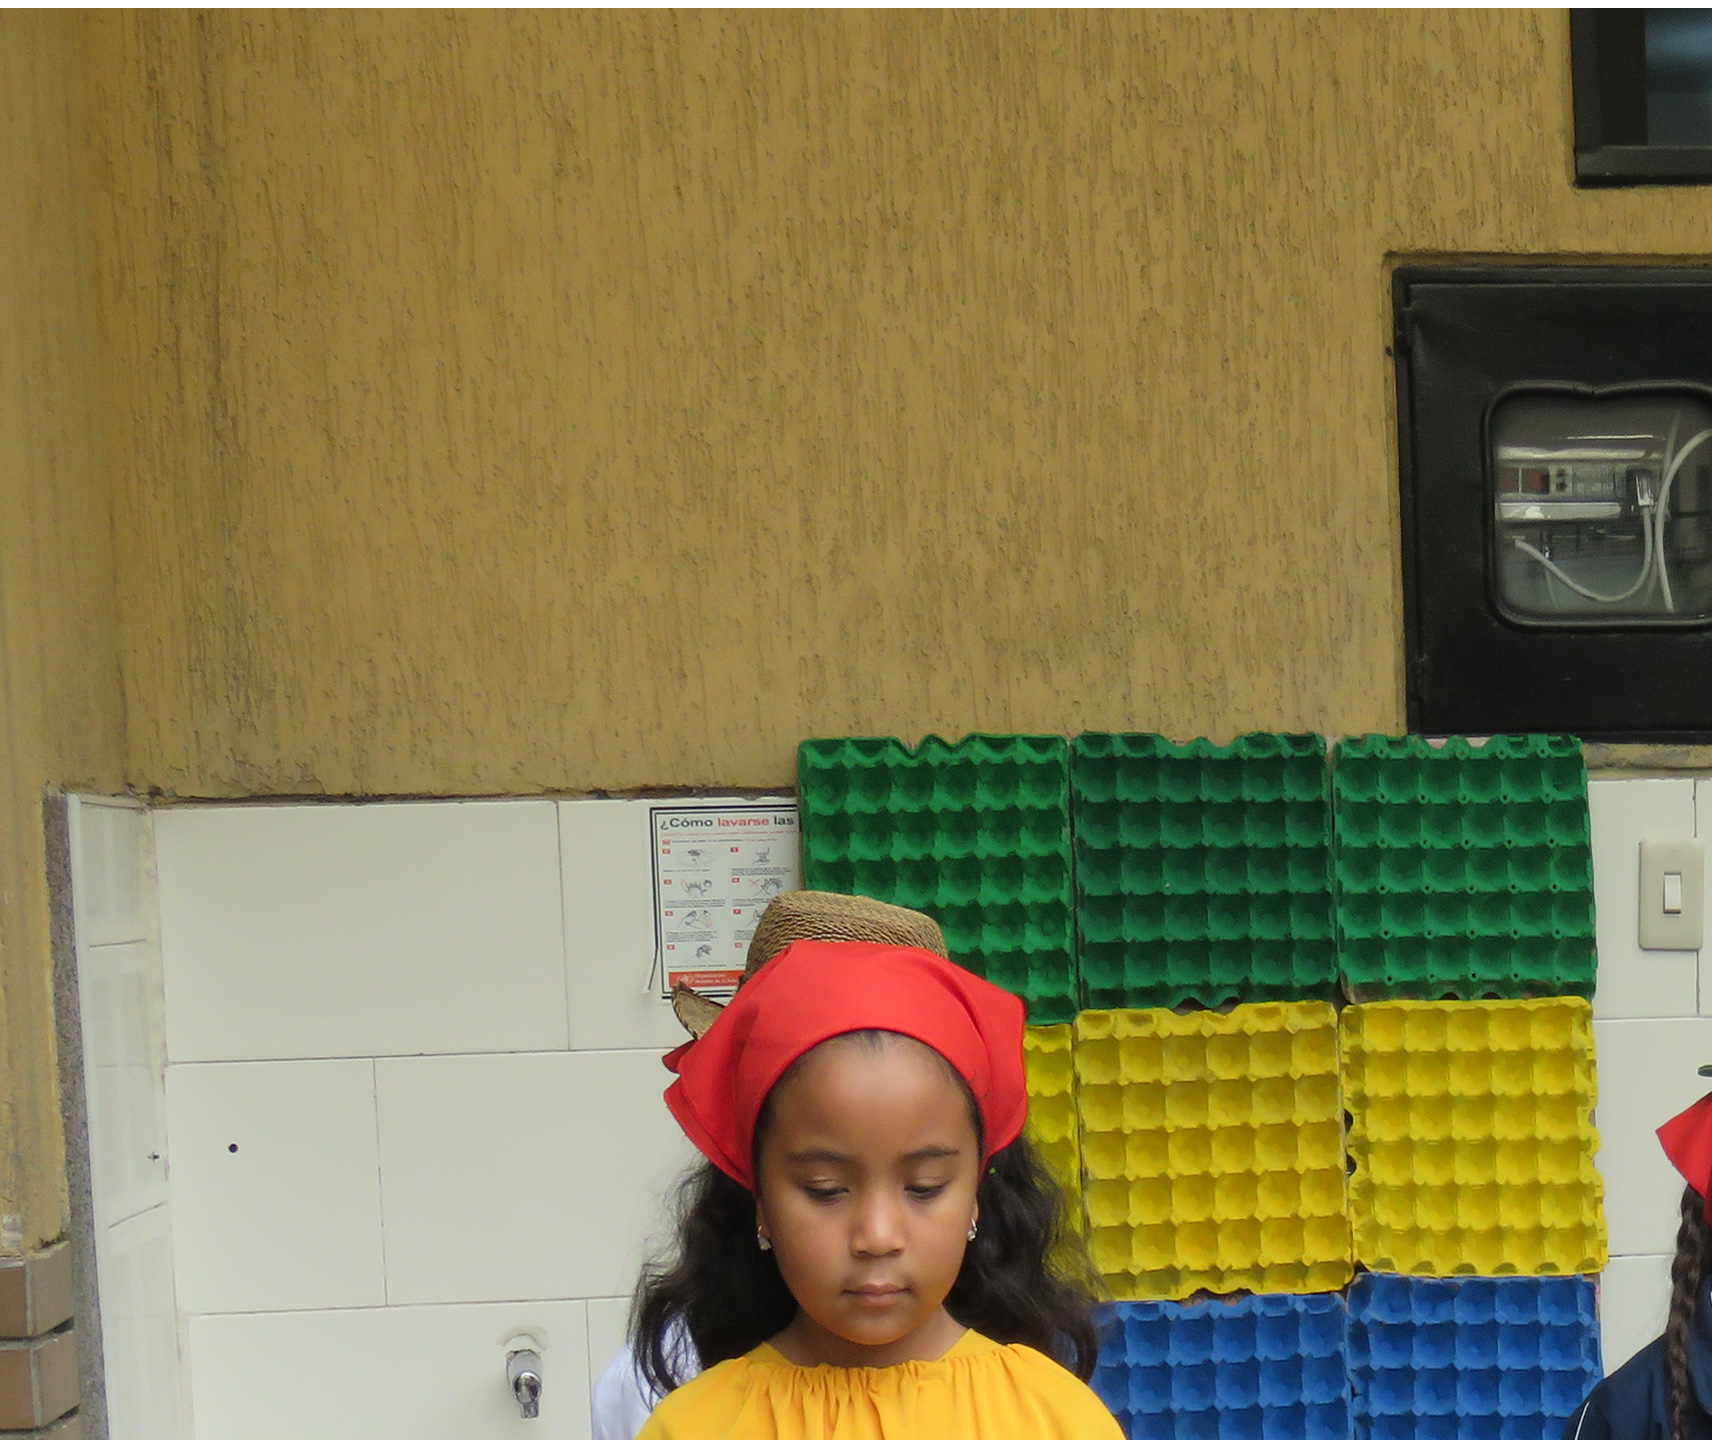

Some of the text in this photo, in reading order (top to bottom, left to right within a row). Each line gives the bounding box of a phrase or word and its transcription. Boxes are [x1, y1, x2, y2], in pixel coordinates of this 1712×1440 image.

[660, 815, 795, 830] ¿Cómo lavarse las
